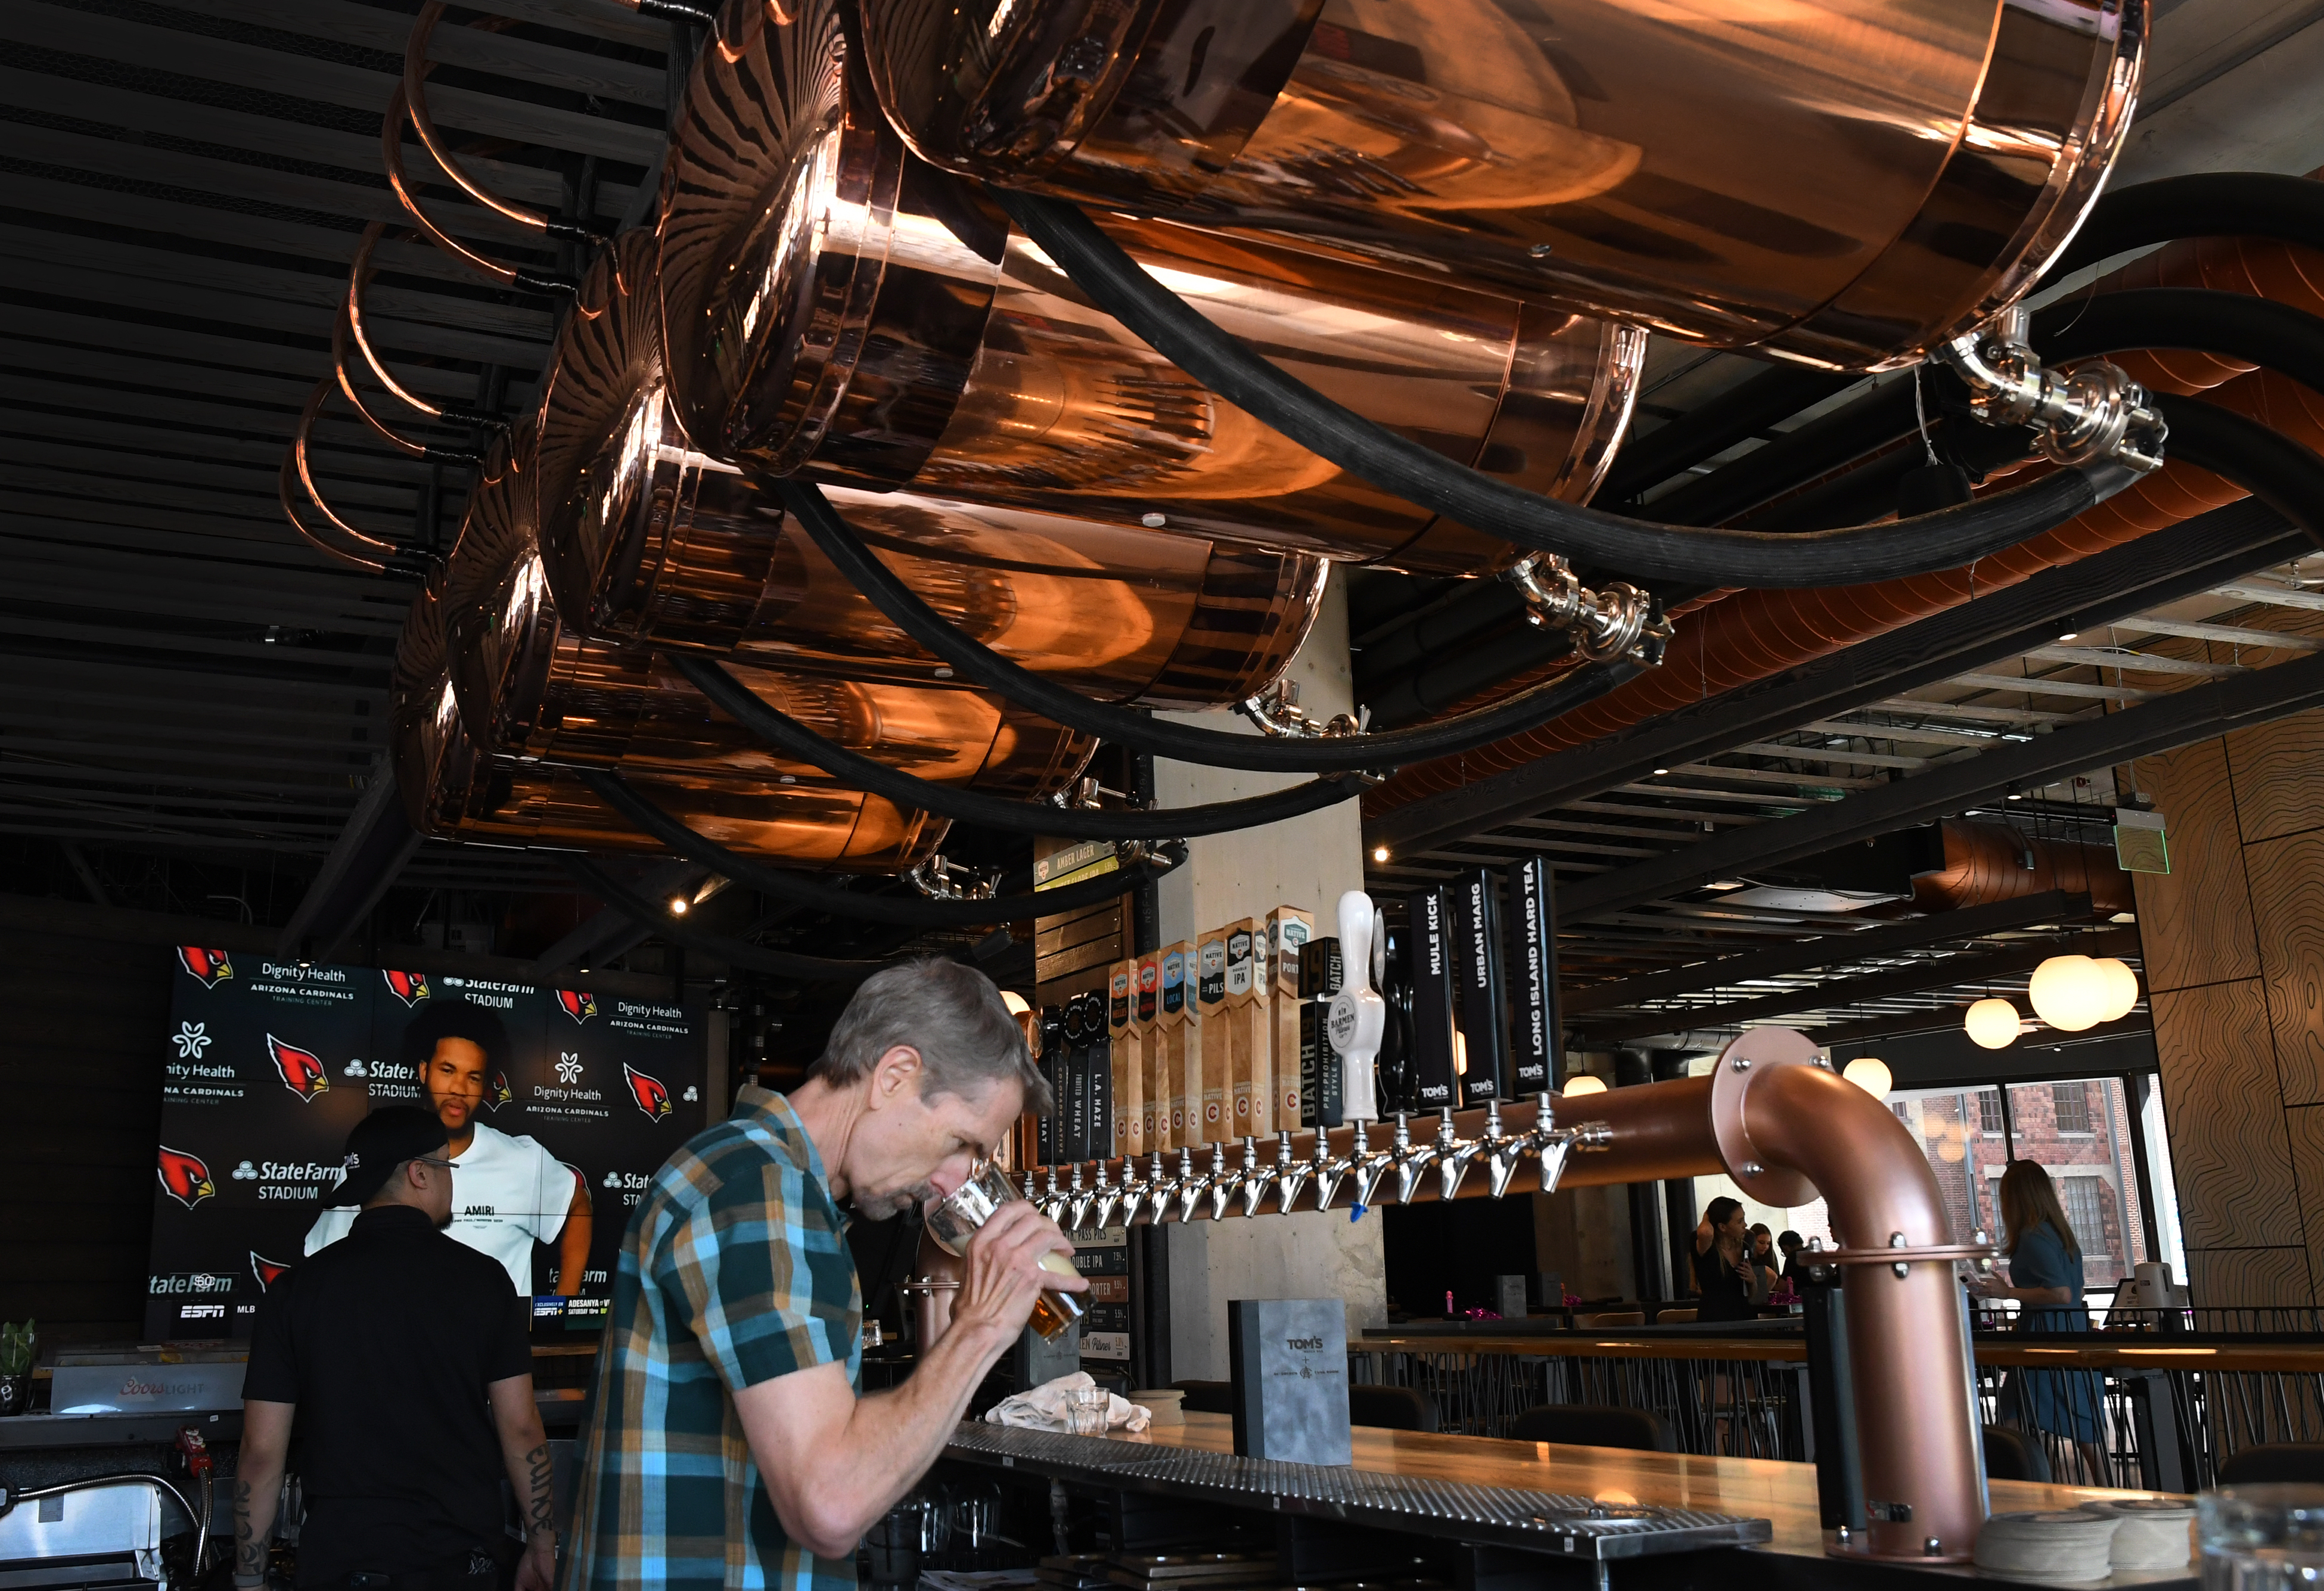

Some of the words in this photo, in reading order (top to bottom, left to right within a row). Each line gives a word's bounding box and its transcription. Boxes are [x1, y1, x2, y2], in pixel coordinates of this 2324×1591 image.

[1057, 854, 1075, 870] AMBER
[1076, 845, 1095, 862] LAGER
[1523, 861, 1534, 895] TEA
[1427, 894, 1438, 931] KICK
[1471, 883, 1483, 930] MARG
[1525, 897, 1537, 943] HARD
[1286, 929, 1305, 939] NATIVE
[1232, 940, 1247, 949] NATIVE
[1429, 933, 1441, 975] MULE
[1474, 932, 1487, 988] URBAN
[262, 962, 306, 981] Dignity
[307, 967, 346, 982] Health
[1167, 962, 1180, 971] NATIVE
[1282, 962, 1298, 974] PORT
[1329, 955, 1341, 990] BATCH
[1234, 972, 1245, 985] IPA
[1528, 946, 1540, 1006] ISLAND
[250, 984, 297, 995] ARIZONA
[299, 989, 354, 1000] CARDINALS
[1208, 982, 1224, 994] PILS
[465, 993, 513, 1009] STADIUM
[1167, 992, 1180, 1004] LOCAL
[618, 1002, 651, 1018] Dignity
[653, 1006, 682, 1018] Health
[610, 1020, 644, 1029] ARIZONA
[647, 1024, 688, 1034] CARDINALS
[1331, 1013, 1354, 1029] BARMEN
[1531, 1009, 1542, 1056] LONG
[166, 1062, 191, 1080] nity
[192, 1064, 235, 1078] Health
[369, 1061, 418, 1080] State
[1518, 1062, 1543, 1078] TOM'S
[1301, 1043, 1315, 1118] BATCH
[1470, 1079, 1494, 1093] TOM'S
[183, 1087, 244, 1097] CARDINALS
[534, 1086, 568, 1101] Dignity
[570, 1089, 601, 1101] Health
[1421, 1083, 1449, 1098] TOM'S
[564, 1108, 609, 1117] CARDINALS
[1074, 1099, 1082, 1138] WHEAT
[623, 1173, 650, 1189] Stat
[258, 1186, 318, 1200] STADIUM
[464, 1205, 494, 1216] AMIRI
[1079, 1228, 1091, 1241] PASS
[1094, 1228, 1107, 1240] PILS
[1092, 1255, 1103, 1267] IPA
[149, 1275, 232, 1294] tateFarm
[568, 1299, 599, 1307] ADESANYA
[181, 1305, 225, 1318] ESPN
[1080, 1338, 1090, 1350] EN
[1092, 1337, 1111, 1351] Pilsner
[1287, 1335, 1323, 1350] TOM'S
[120, 1379, 164, 1396] Coors
[165, 1384, 204, 1395] LIGHT
